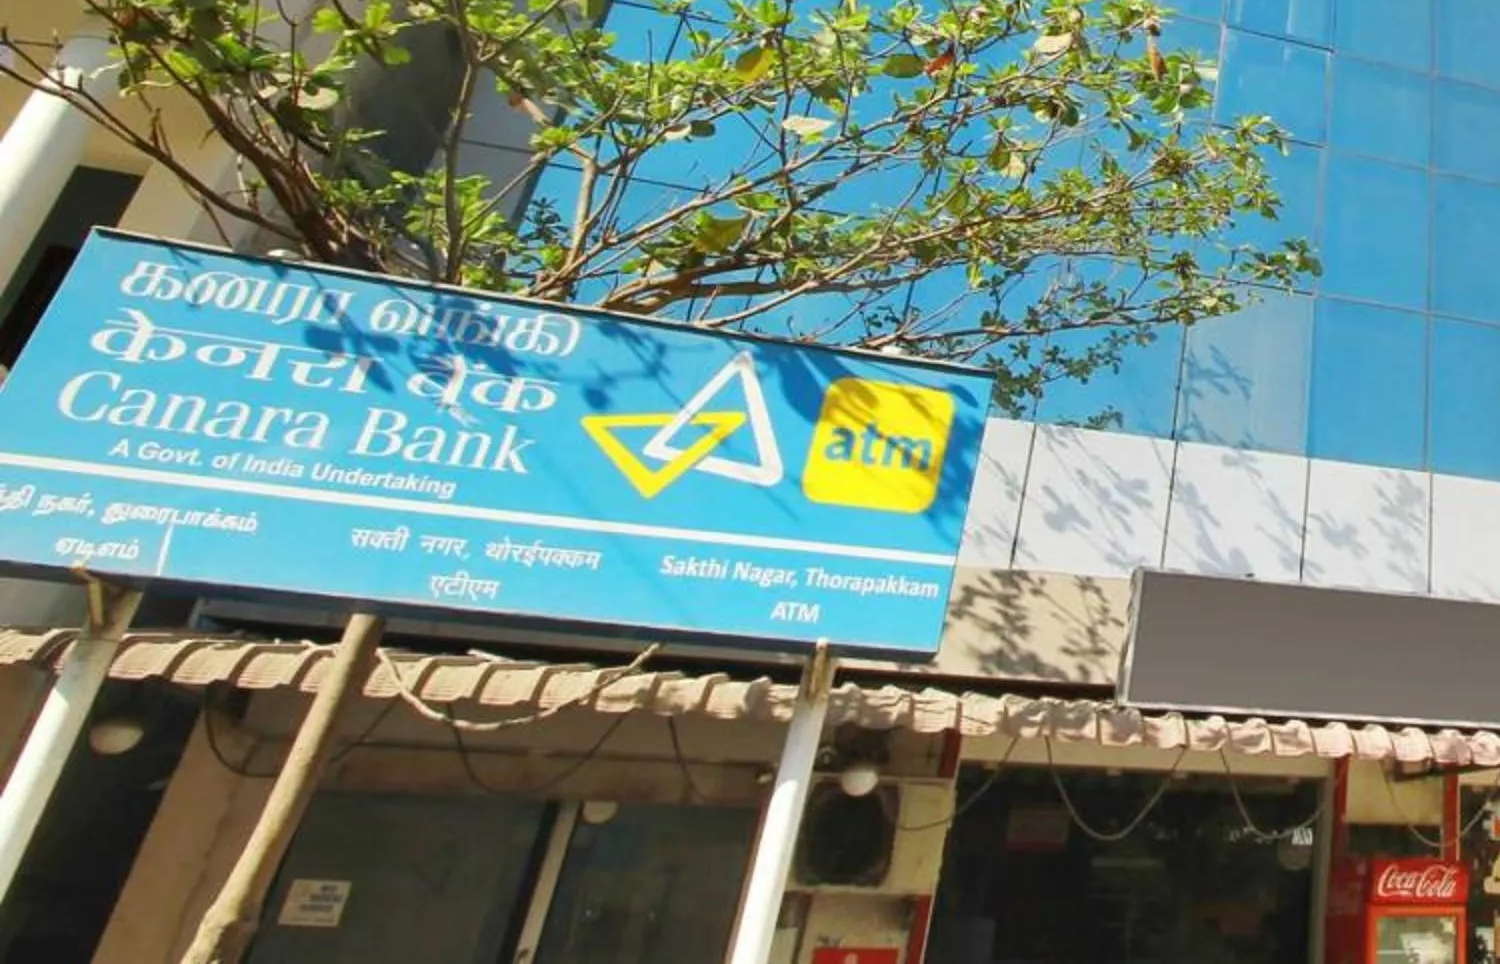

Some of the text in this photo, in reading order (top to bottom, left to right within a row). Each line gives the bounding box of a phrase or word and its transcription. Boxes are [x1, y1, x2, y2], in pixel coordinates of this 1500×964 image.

[57, 370, 535, 474] Canara Bank
[107, 438, 130, 458] A
[212, 452, 241, 471] of
[242, 454, 305, 478] India
[310, 462, 457, 499] Undertaking
[825, 423, 932, 473] atm
[429, 570, 500, 601] एटीएम
[660, 555, 941, 598] Sakthi Nagar, Thorapakkam
[769, 601, 821, 624] ATM
